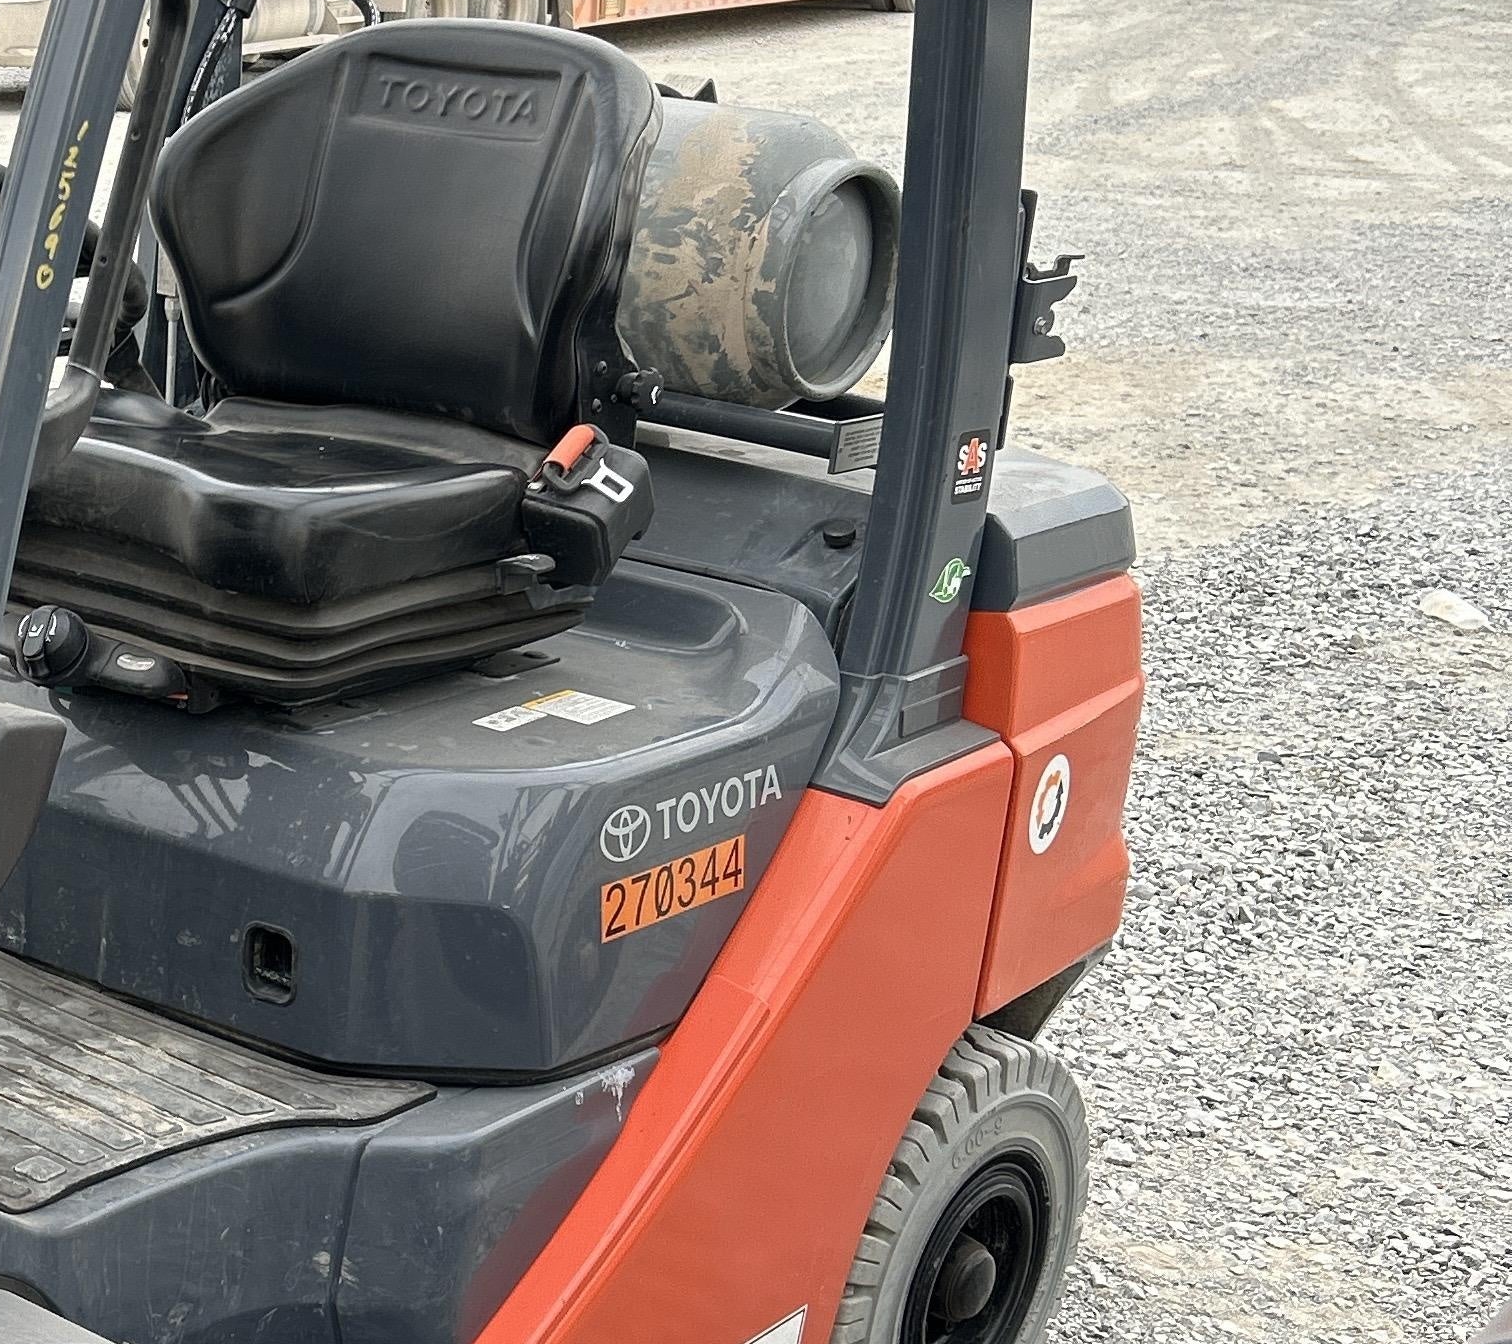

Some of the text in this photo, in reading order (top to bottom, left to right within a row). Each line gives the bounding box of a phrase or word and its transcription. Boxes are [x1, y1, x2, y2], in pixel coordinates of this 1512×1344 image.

[379, 78, 539, 126] TOYOTA
[957, 437, 988, 475] SAS
[656, 765, 783, 839] TOYOTA
[605, 841, 744, 938] 270344
